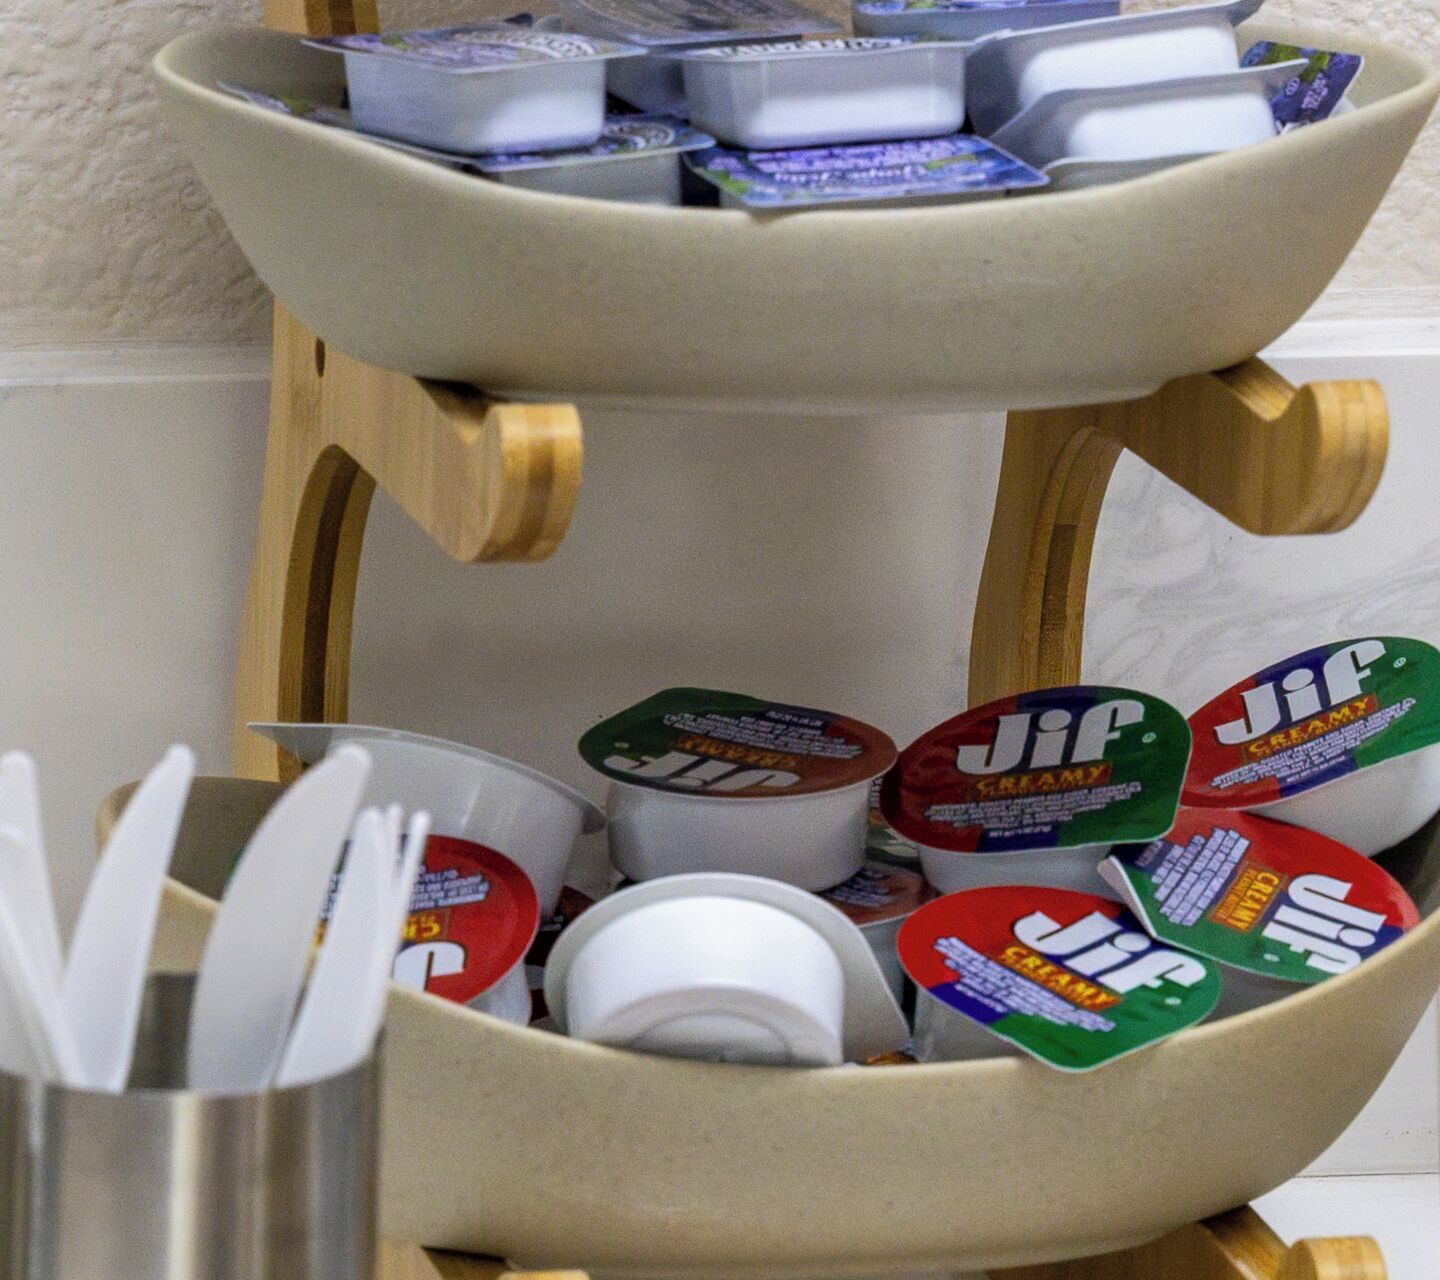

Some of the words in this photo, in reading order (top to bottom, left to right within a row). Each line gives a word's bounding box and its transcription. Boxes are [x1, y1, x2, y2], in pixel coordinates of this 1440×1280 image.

[1214, 640, 1388, 745] Jif
[956, 699, 1146, 775] Jif
[1248, 697, 1371, 754] CREAMY
[602, 750, 801, 792] Jif
[976, 764, 1107, 794] CREAMY
[1227, 872, 1281, 930] CREAMY
[1261, 873, 1388, 974] Jif
[1001, 944, 1116, 1008] CREAMY
[1013, 910, 1208, 995] Jif
